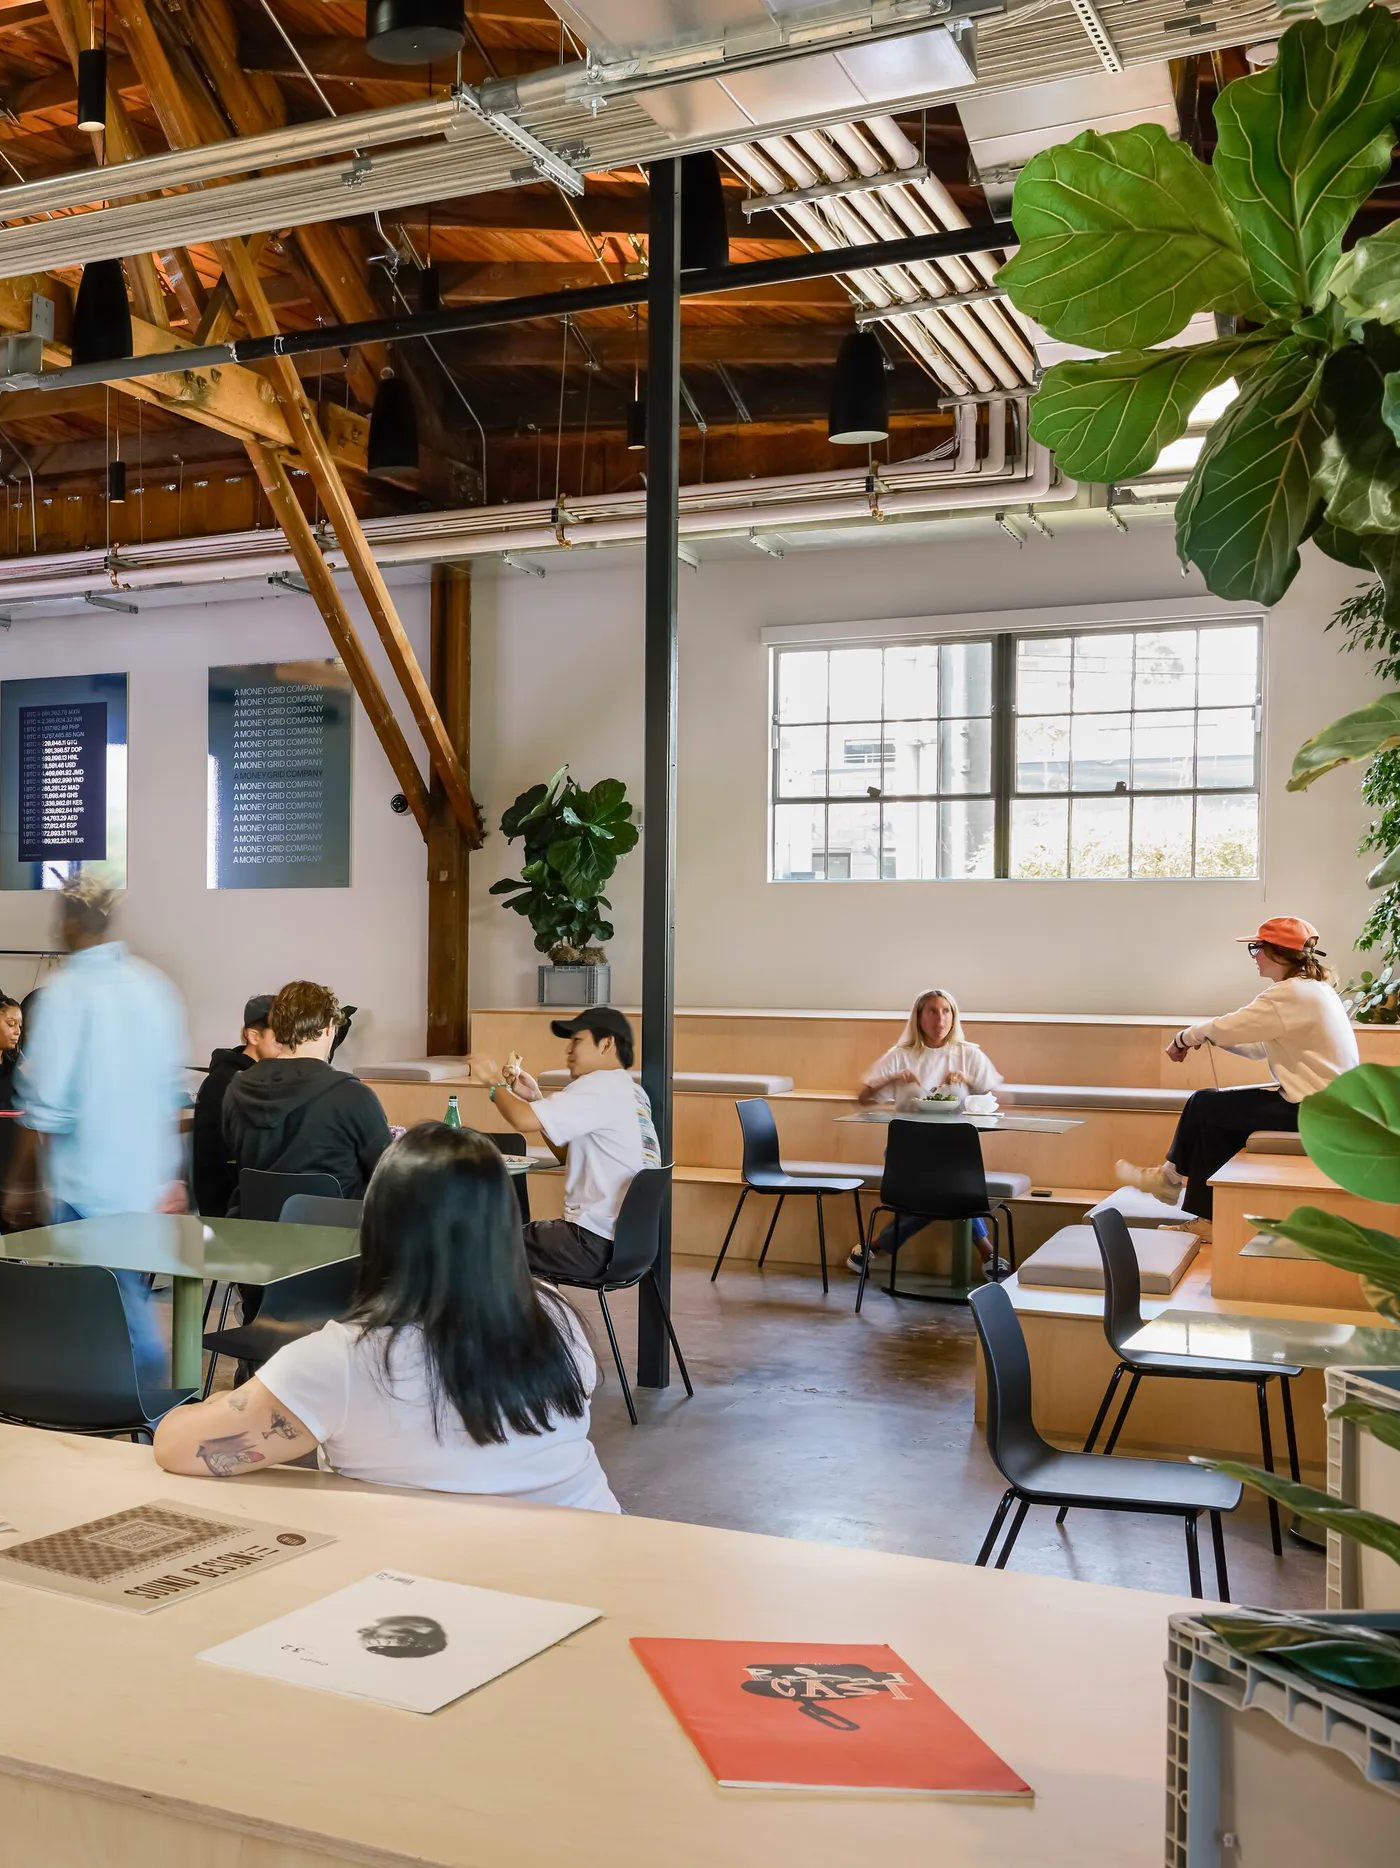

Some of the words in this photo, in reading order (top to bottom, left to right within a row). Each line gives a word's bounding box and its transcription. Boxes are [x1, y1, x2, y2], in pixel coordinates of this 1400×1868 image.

[240, 688, 266, 696] MONEY
[268, 686, 285, 694] GRID
[286, 684, 323, 693] COMPANY
[240, 698, 266, 706] MONEY
[286, 695, 323, 704] COMPANY
[240, 709, 266, 717] MONEY
[267, 707, 285, 715] GRID
[286, 705, 323, 714] COMPANY
[240, 719, 266, 727] MONEY
[286, 716, 323, 725] COMPANY
[240, 730, 266, 738] MONEY
[286, 727, 323, 735] COMPANY
[240, 740, 266, 748] MONEY
[267, 739, 285, 747] GRID
[286, 738, 323, 746] COMPANY
[240, 751, 266, 759] MONEY
[286, 748, 323, 757] COMPANY
[240, 761, 266, 769] MONEY
[267, 760, 285, 768] GRID
[286, 759, 323, 767] COMPANY
[240, 772, 266, 780] MONEY
[286, 770, 323, 778] COMPANY
[240, 782, 266, 790] MONEY
[286, 780, 323, 788] COMPANY
[286, 791, 323, 799] COMPANY
[286, 802, 323, 810] COMPANY
[286, 812, 323, 820] COMPANY
[286, 823, 323, 831] COMPANY
[286, 844, 323, 852] COMPANY
[286, 855, 322, 863] COMPANY
[124, 1574, 200, 1600] SOUND
[770, 1678, 914, 1701] CAST
